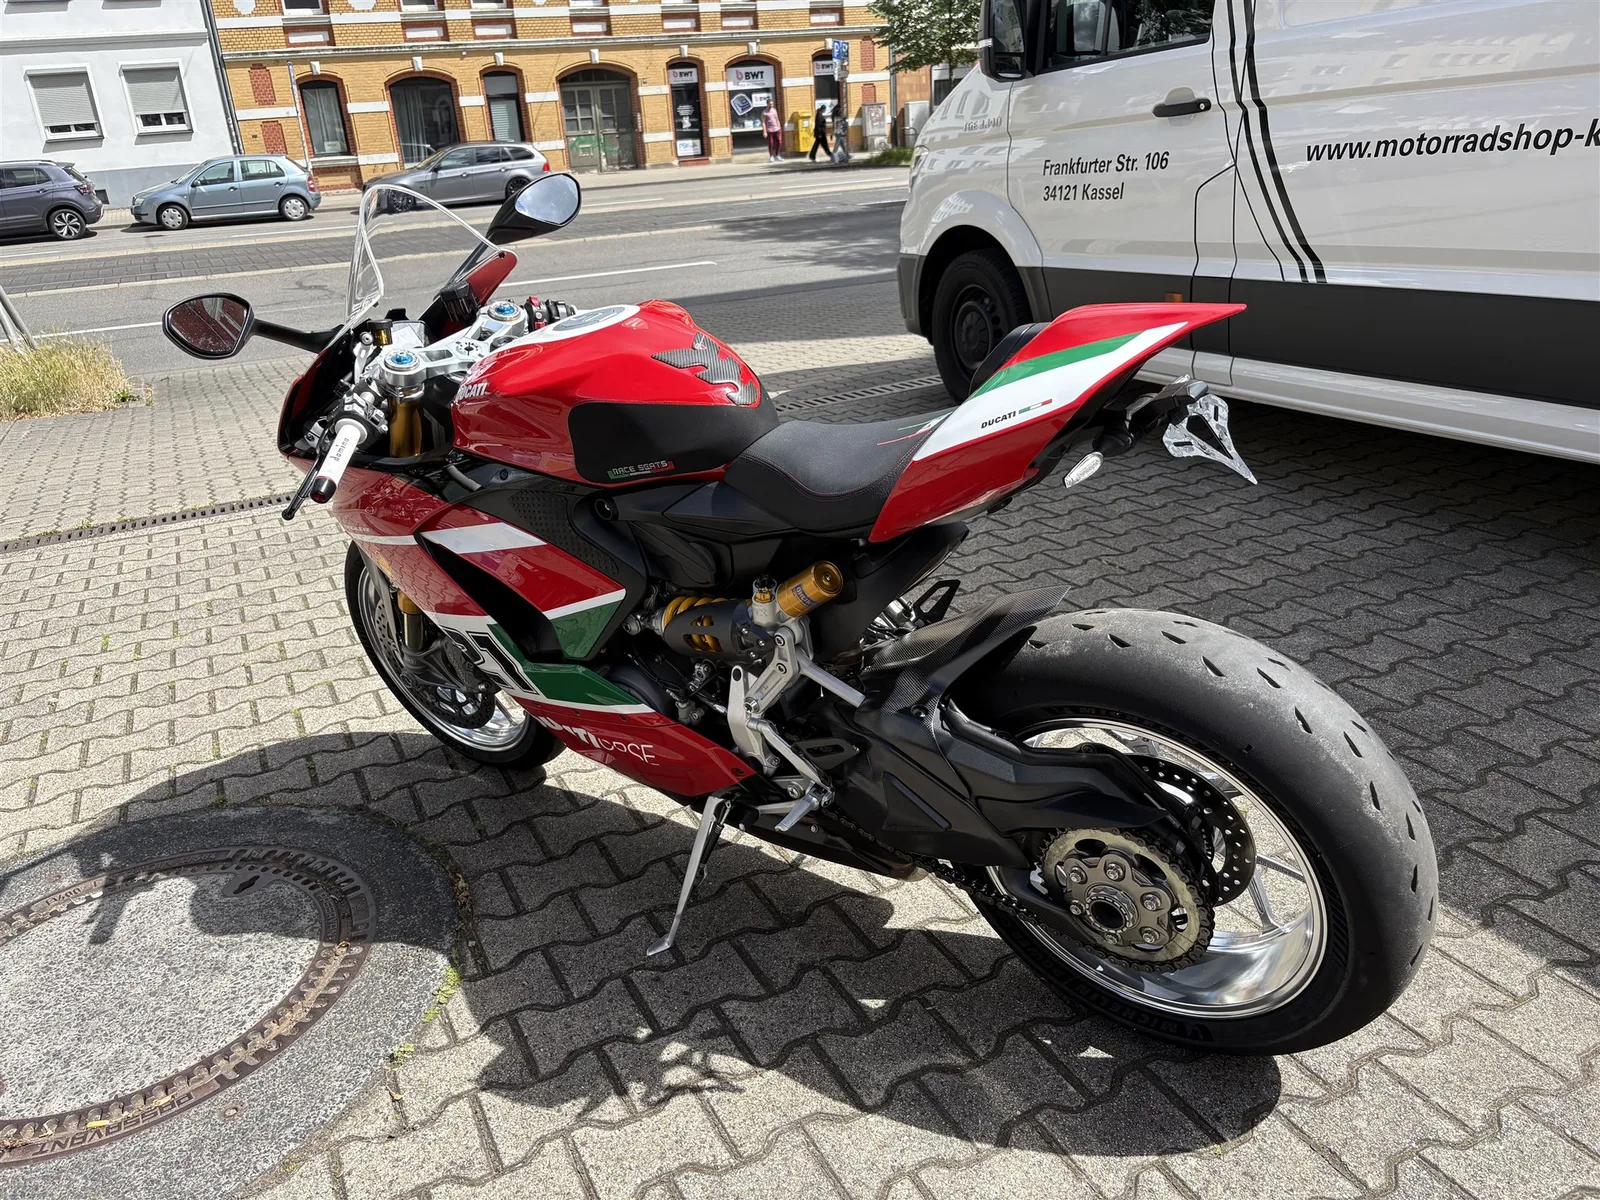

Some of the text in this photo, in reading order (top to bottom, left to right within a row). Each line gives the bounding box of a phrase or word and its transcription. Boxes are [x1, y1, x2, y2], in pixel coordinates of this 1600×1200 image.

[744, 71, 764, 80] BWT
[1306, 118, 1600, 163] www.motorradshop-k
[1043, 151, 1170, 176] Frankfurter Str. 106
[1043, 182, 1124, 201] 34121 Kassel
[981, 410, 1017, 429] DUCATI
[330, 437, 350, 462] domino
[612, 460, 668, 475] RACE SEATS
[1073, 983, 1179, 1034] MICHELIN
[32, 1094, 194, 1156] PASSAVANT
